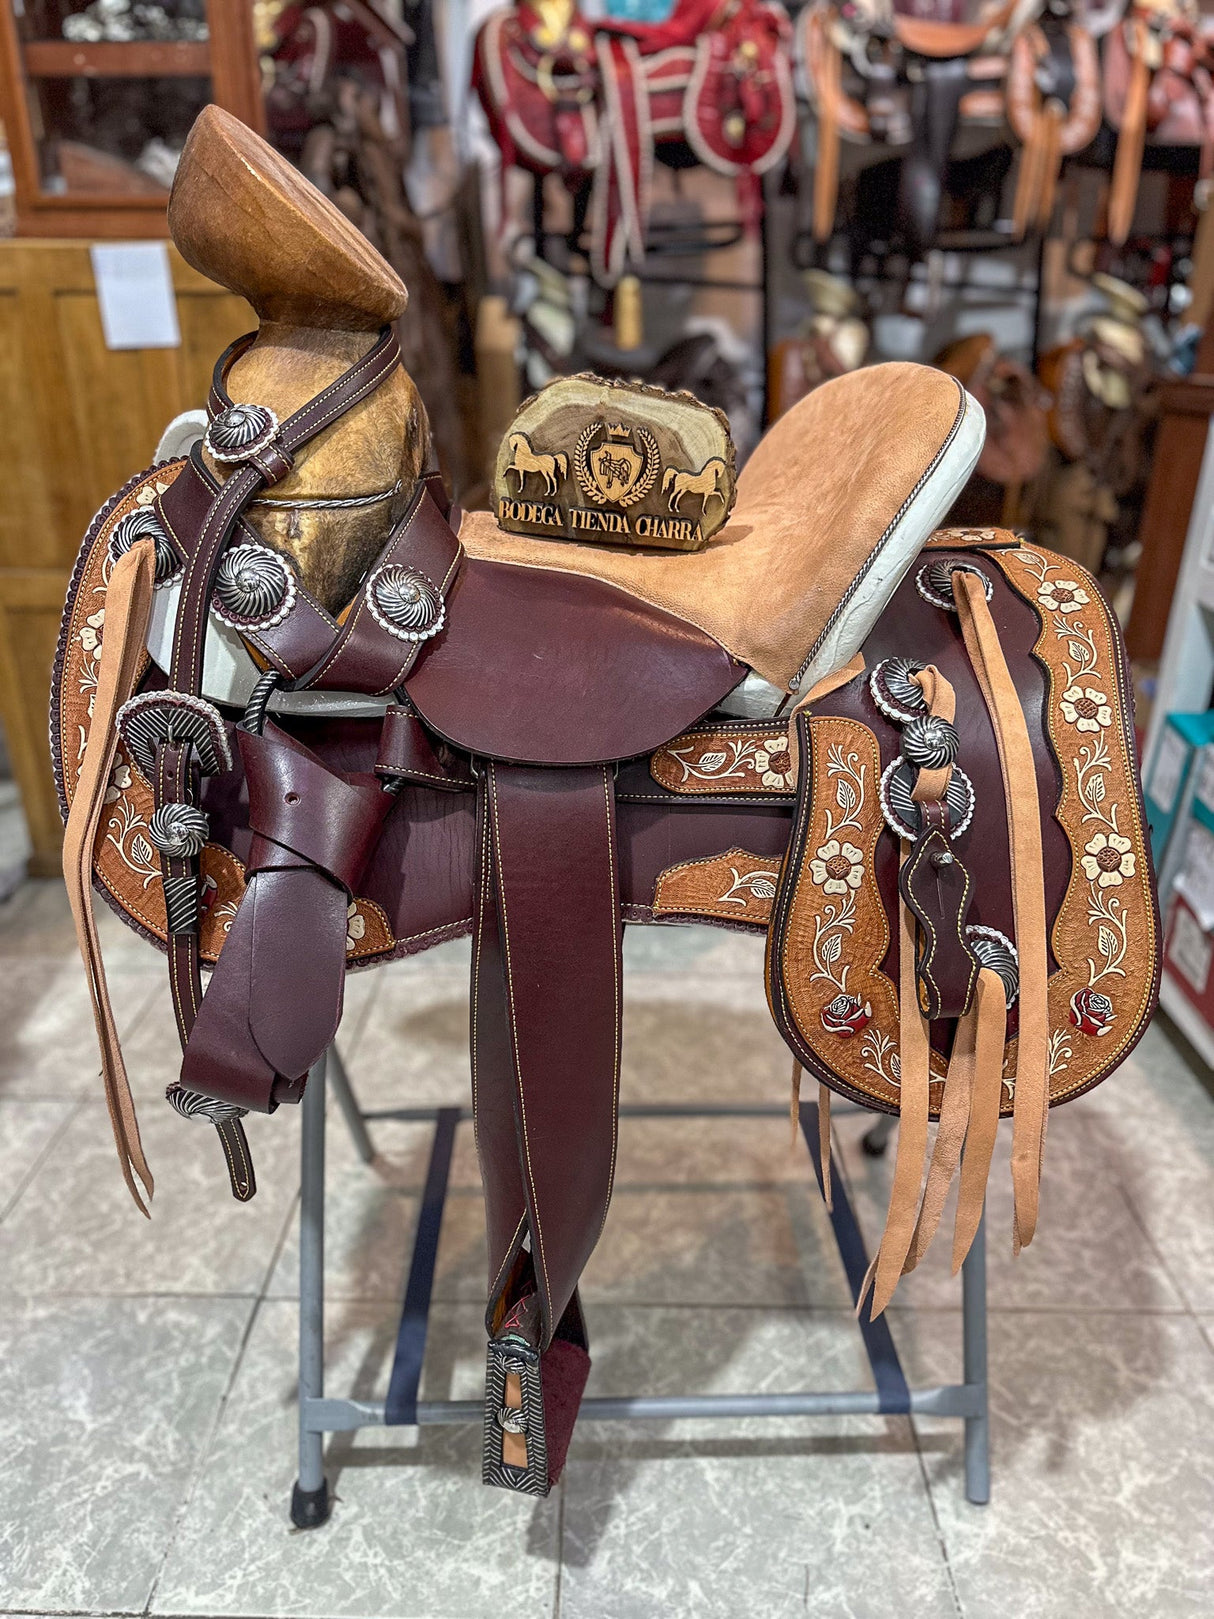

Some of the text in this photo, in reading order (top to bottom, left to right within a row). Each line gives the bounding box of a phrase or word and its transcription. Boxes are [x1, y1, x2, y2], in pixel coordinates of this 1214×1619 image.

[499, 499, 704, 541] BODEGA TIENDA CHARRA
